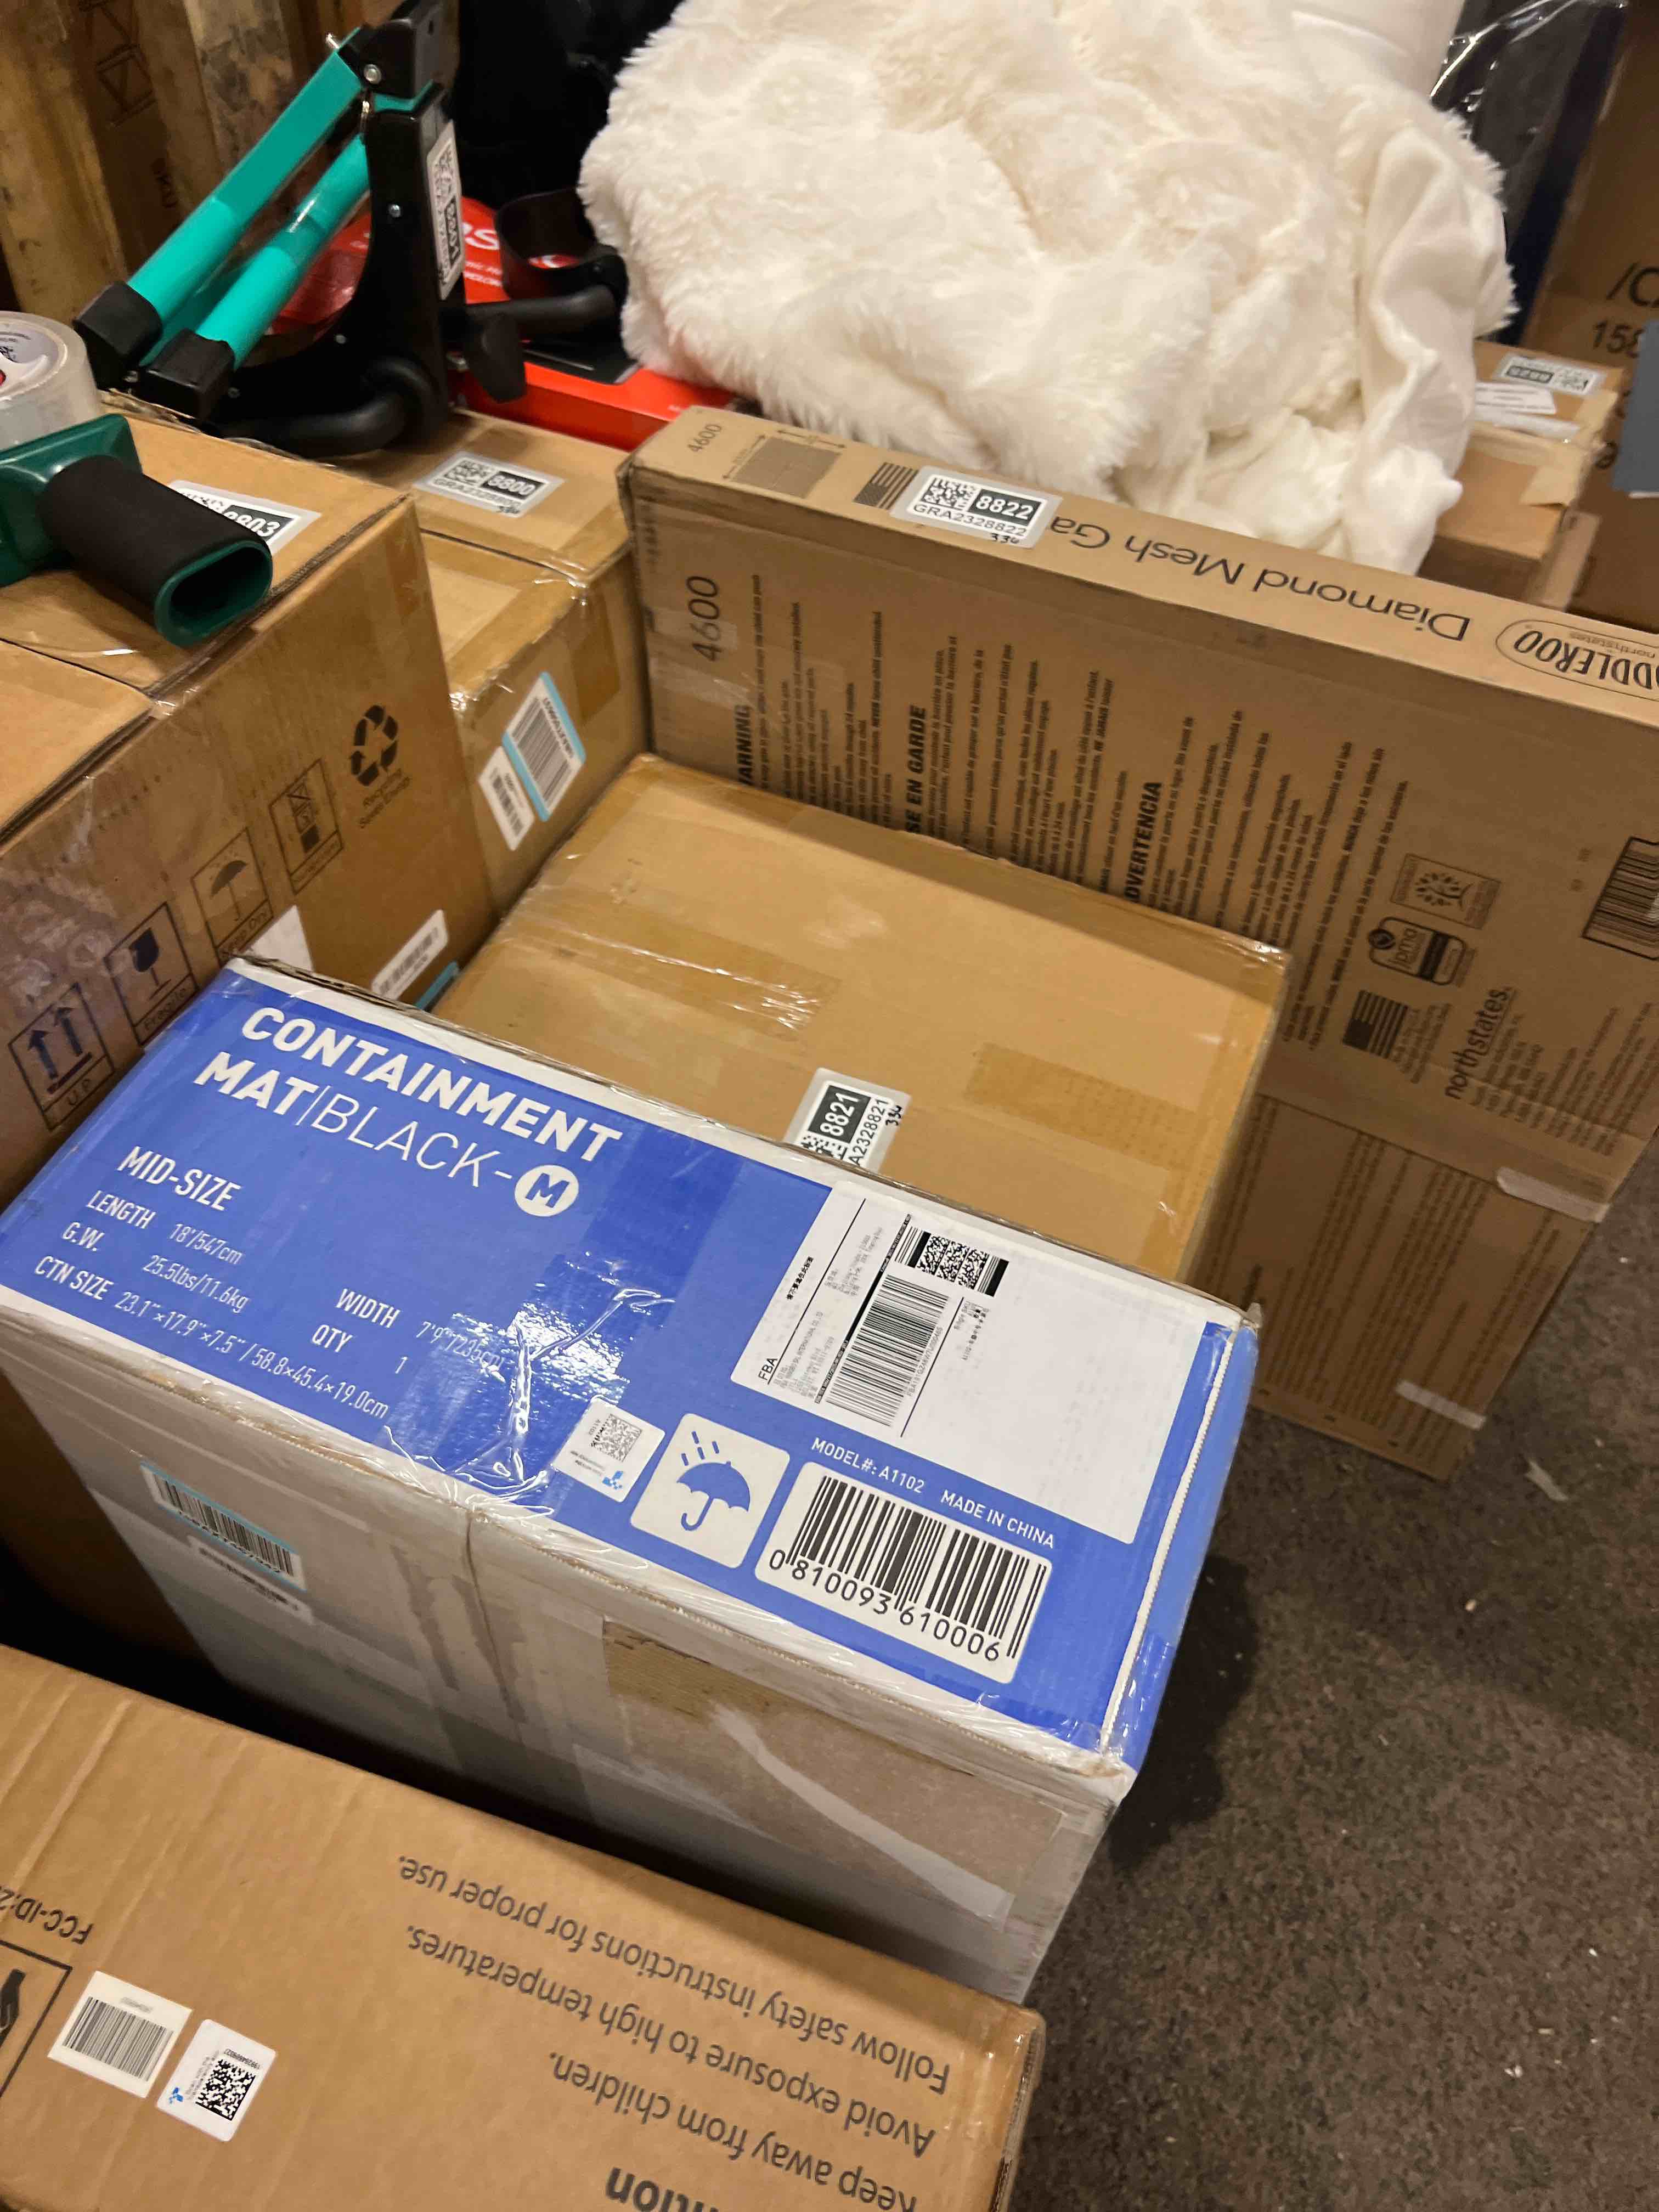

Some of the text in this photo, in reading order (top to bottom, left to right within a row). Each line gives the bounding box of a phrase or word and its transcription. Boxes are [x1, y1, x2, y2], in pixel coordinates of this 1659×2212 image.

[1606, 261, 1659, 309] /C
[687, 423, 722, 453] 4600
[913, 504, 1028, 537] GRA2328822
[975, 495, 1034, 520] 8822
[1049, 515, 1471, 642] Diamond Mesh Ga
[686, 575, 723, 661] 4600
[1514, 630, 1659, 690] DDLEROO
[907, 704, 926, 774] GARDE
[906, 778, 923, 805] EN
[1124, 781, 1161, 902] DVERTENCIA
[240, 1007, 623, 1163] CONTAINMENT
[820, 1092, 861, 1137] 8821
[848, 1098, 890, 1166] A2328821
[116, 1145, 242, 1211] MID-SIZE
[525, 1172, 570, 1209] M
[86, 1189, 157, 1229] LENGTH
[34, 1255, 75, 1284] CTN
[69, 1270, 115, 1301] SIZE
[61, 1221, 251, 1313] G.W. 25.5lbs/11.6kg
[335, 1288, 402, 1329] WIDTH
[311, 1324, 409, 1374] QTY 1
[757, 1355, 778, 1381] FBA
[811, 1437, 1056, 1550] MODEL#: A1102 MADE IN CHINA
[399, 1855, 950, 2096] Follow safety instructions for proper use.
[407, 1925, 937, 2159] Avoid exposure to high temperatures.
[549, 2052, 672, 2125] children.
[676, 2103, 749, 2161] from
[751, 2130, 834, 2186] away
